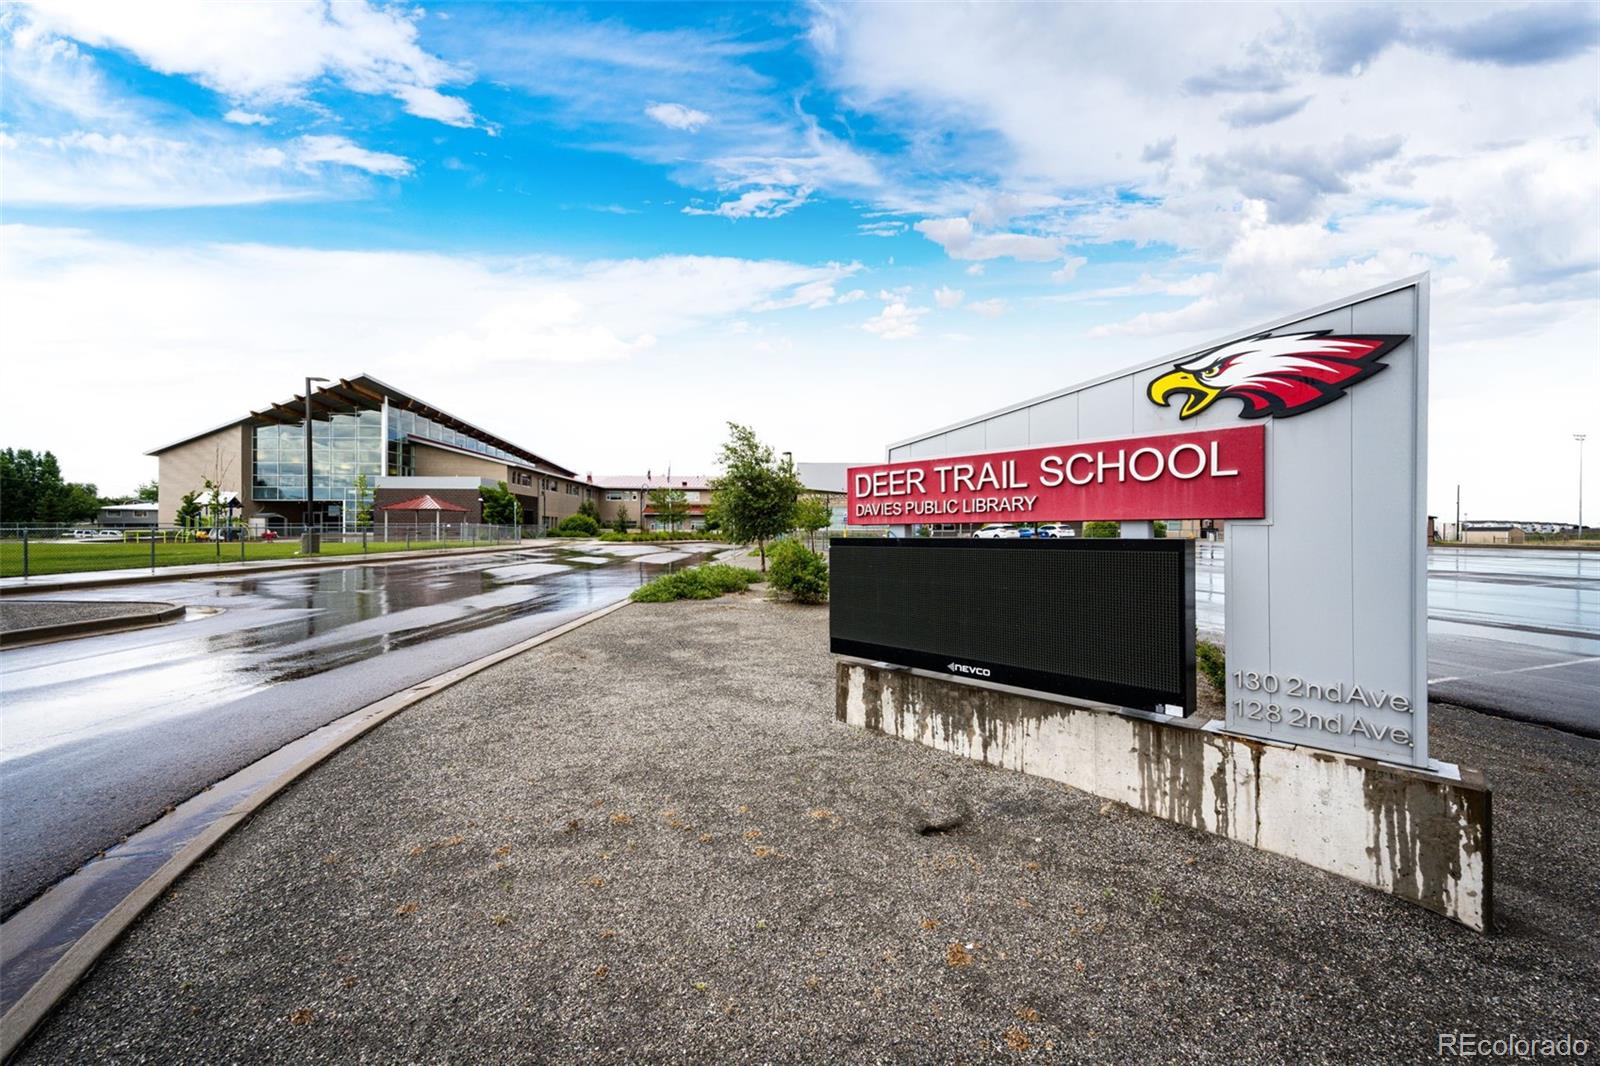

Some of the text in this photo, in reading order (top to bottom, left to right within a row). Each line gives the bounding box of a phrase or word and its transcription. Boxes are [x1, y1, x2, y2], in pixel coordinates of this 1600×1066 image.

[855, 441, 1239, 499] DEER TRAIL SCHOOL
[856, 495, 1037, 517] DAVIES PUBLIC LIBRARY
[1233, 670, 1279, 693] 130
[1286, 677, 1343, 703] 2nd
[1233, 700, 1282, 723] 128
[1288, 706, 1344, 734] 2nd
